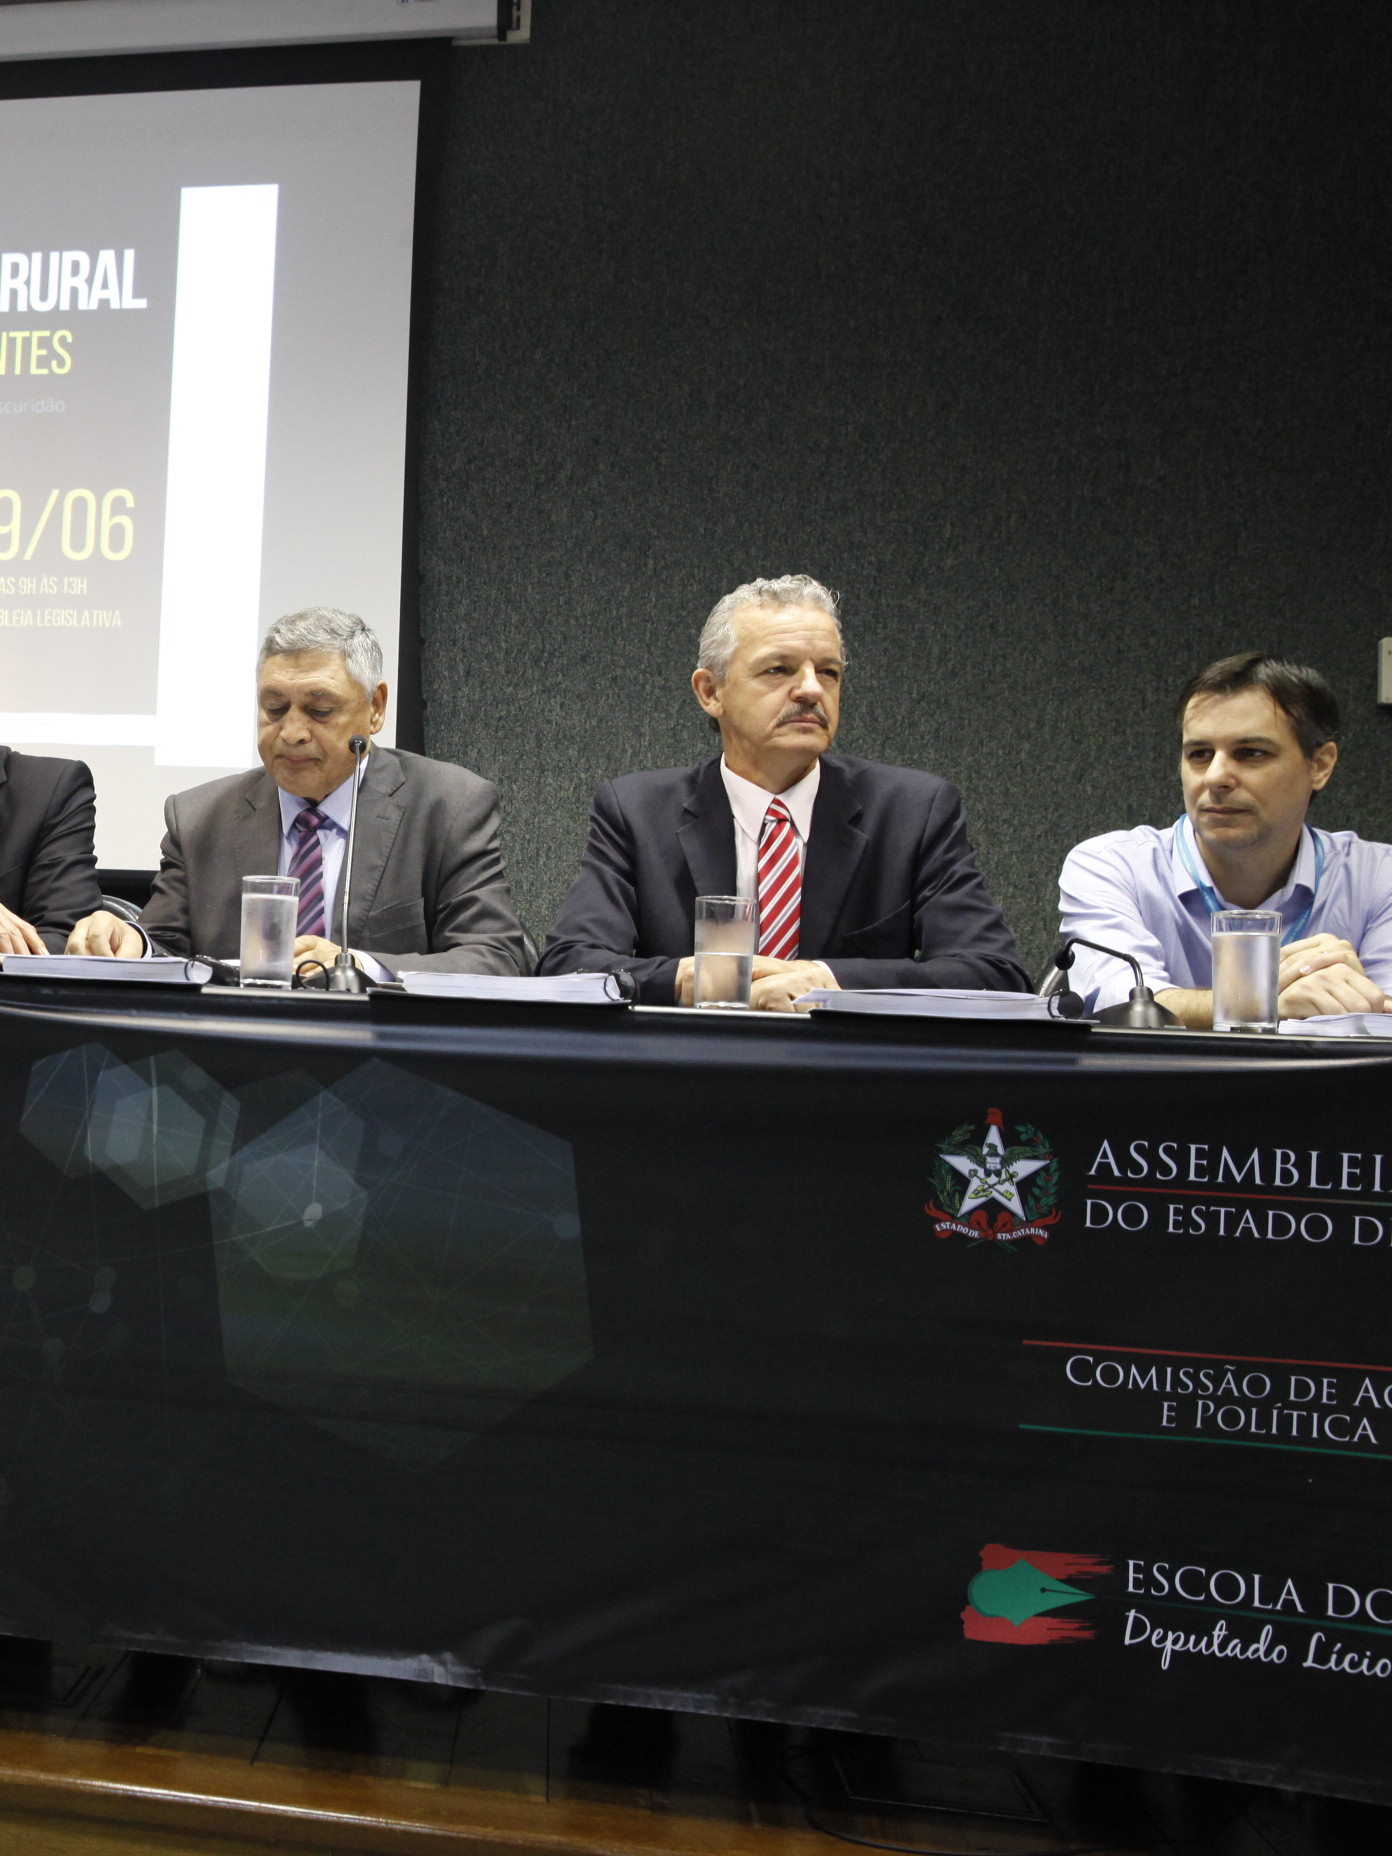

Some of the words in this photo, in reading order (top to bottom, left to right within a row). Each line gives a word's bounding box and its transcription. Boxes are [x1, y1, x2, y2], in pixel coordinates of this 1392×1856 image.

[0, 249, 147, 312] RURAL
[18, 577, 36, 595] 9H
[39, 573, 58, 595] ÀS
[63, 576, 87, 595] 13H
[36, 609, 121, 627] LEGISLATIVA
[1086, 1138, 1392, 1192] ASSEMBLEI
[935, 1221, 969, 1234] ESTADO
[1084, 1199, 1149, 1231] DO
[1166, 1204, 1333, 1243] ESTADO
[1352, 1215, 1392, 1247] D
[1065, 1355, 1271, 1399] COMISSÃO
[1289, 1375, 1337, 1405] DE
[1160, 1401, 1177, 1428] E
[1195, 1399, 1379, 1445] POLÍTICA
[1125, 1559, 1307, 1614] ESCOLA
[1124, 1609, 1288, 1670] Deputado
[1302, 1632, 1392, 1678] Lício
